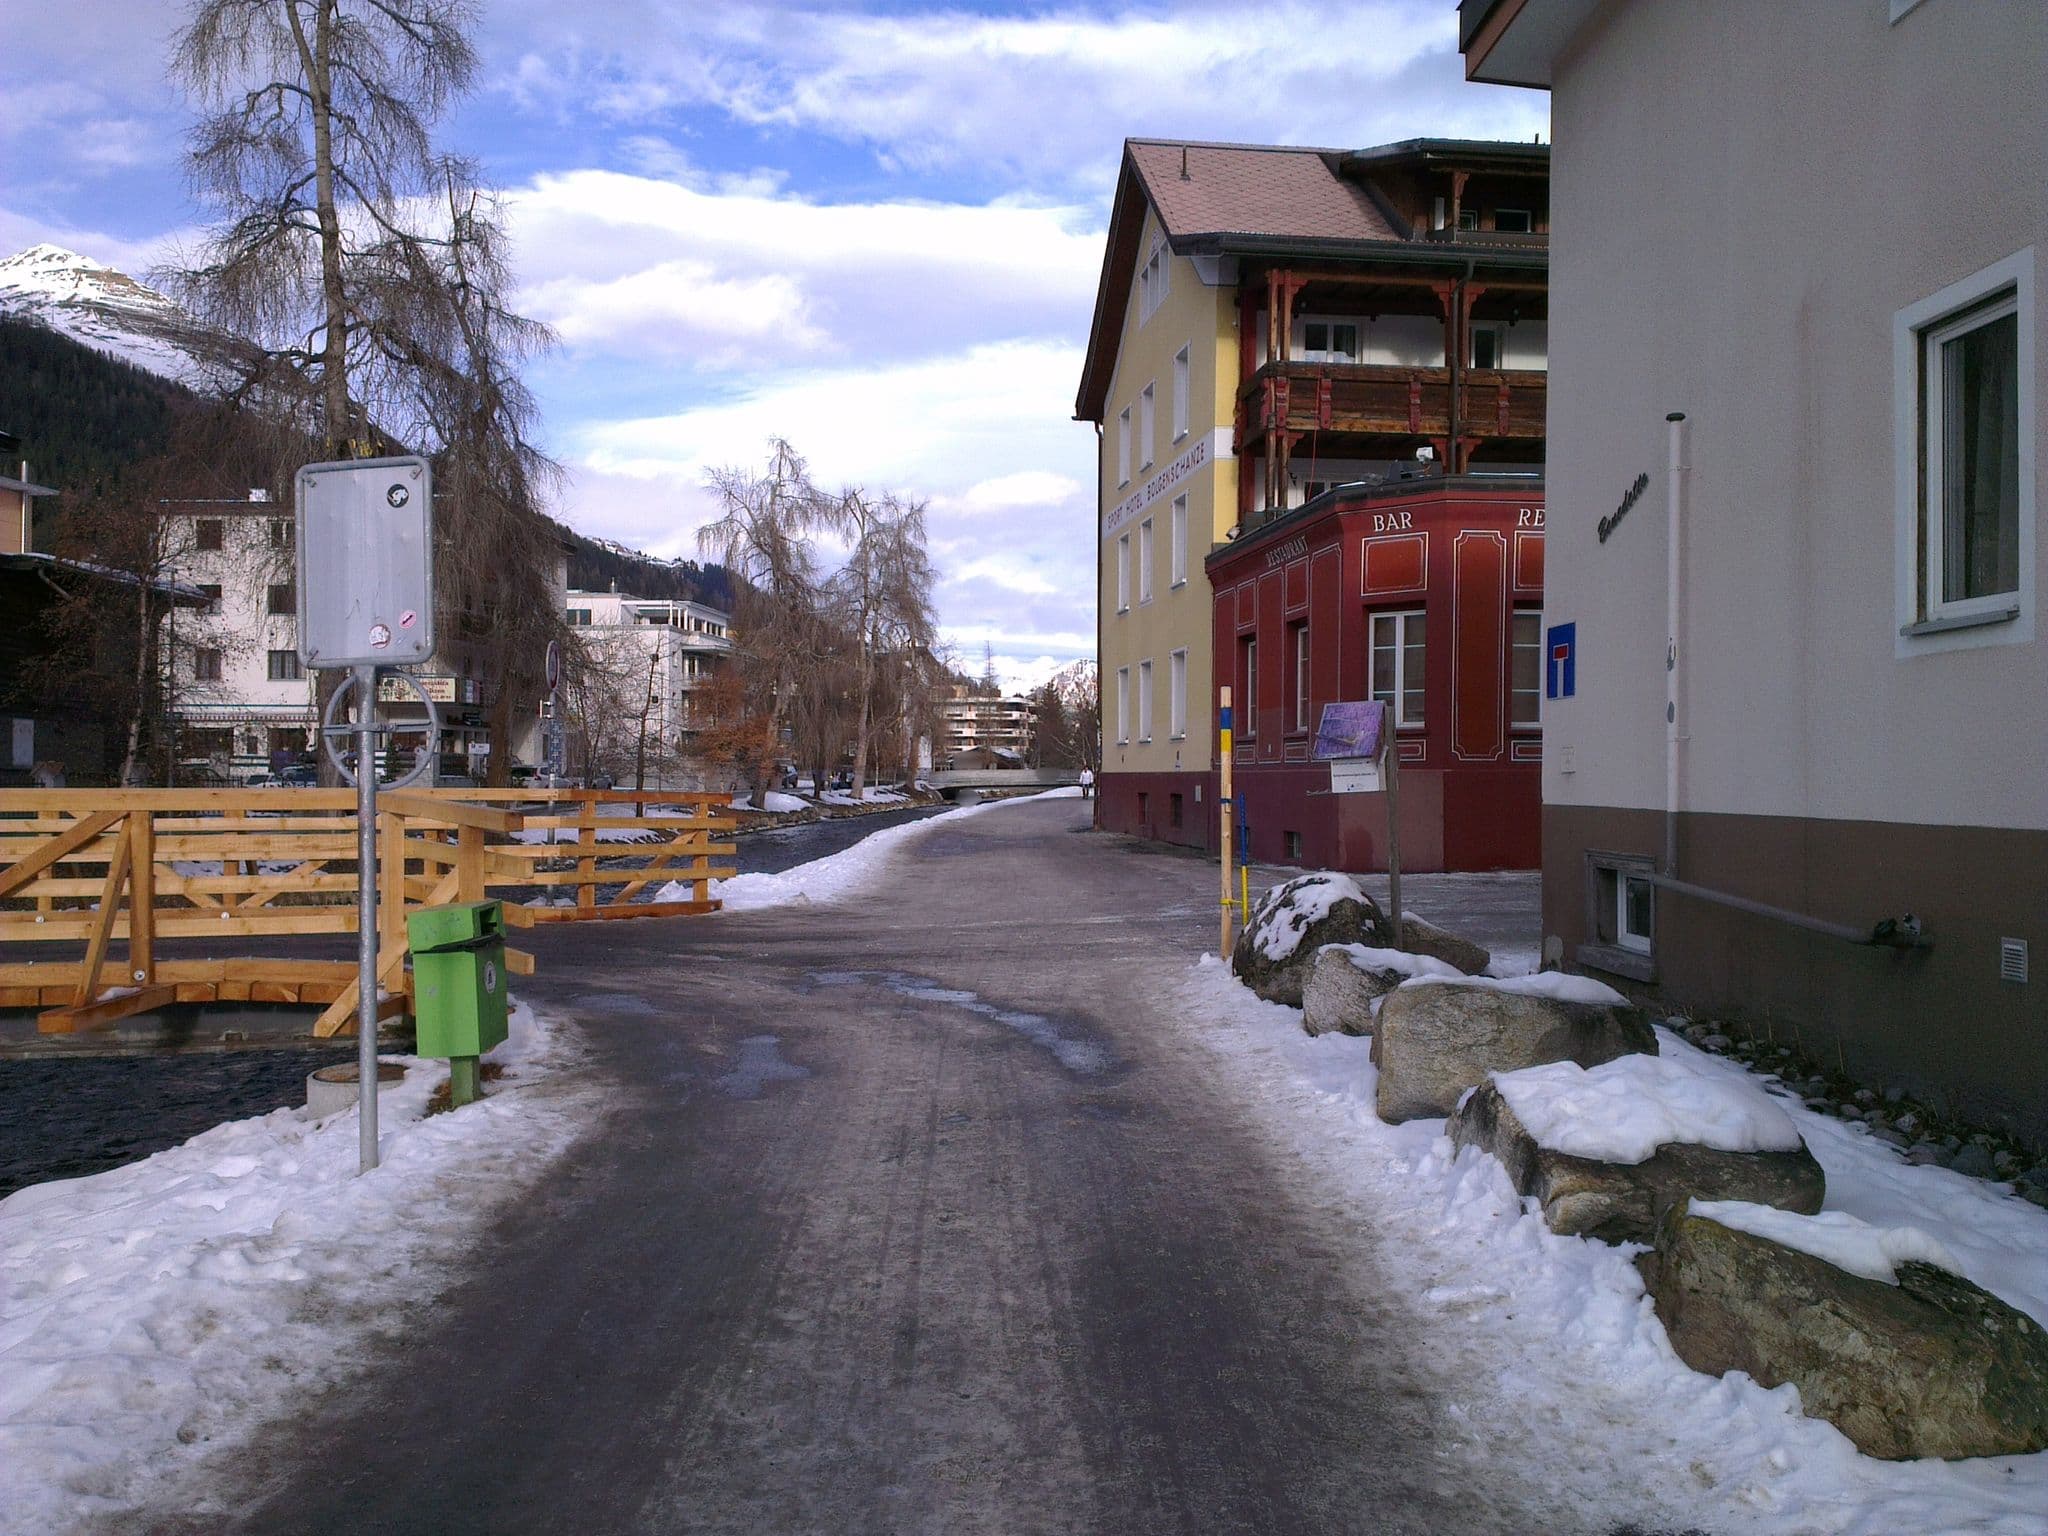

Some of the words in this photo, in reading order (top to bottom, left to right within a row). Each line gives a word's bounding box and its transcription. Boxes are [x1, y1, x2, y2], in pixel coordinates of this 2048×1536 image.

[1106, 506, 1123, 529] SPORT
[1126, 492, 1143, 514] HOTEL
[1146, 441, 1205, 501] BOLGENSCHANZE
[1373, 511, 1413, 532] BAR
[1265, 535, 1308, 567] RESTAURANT
